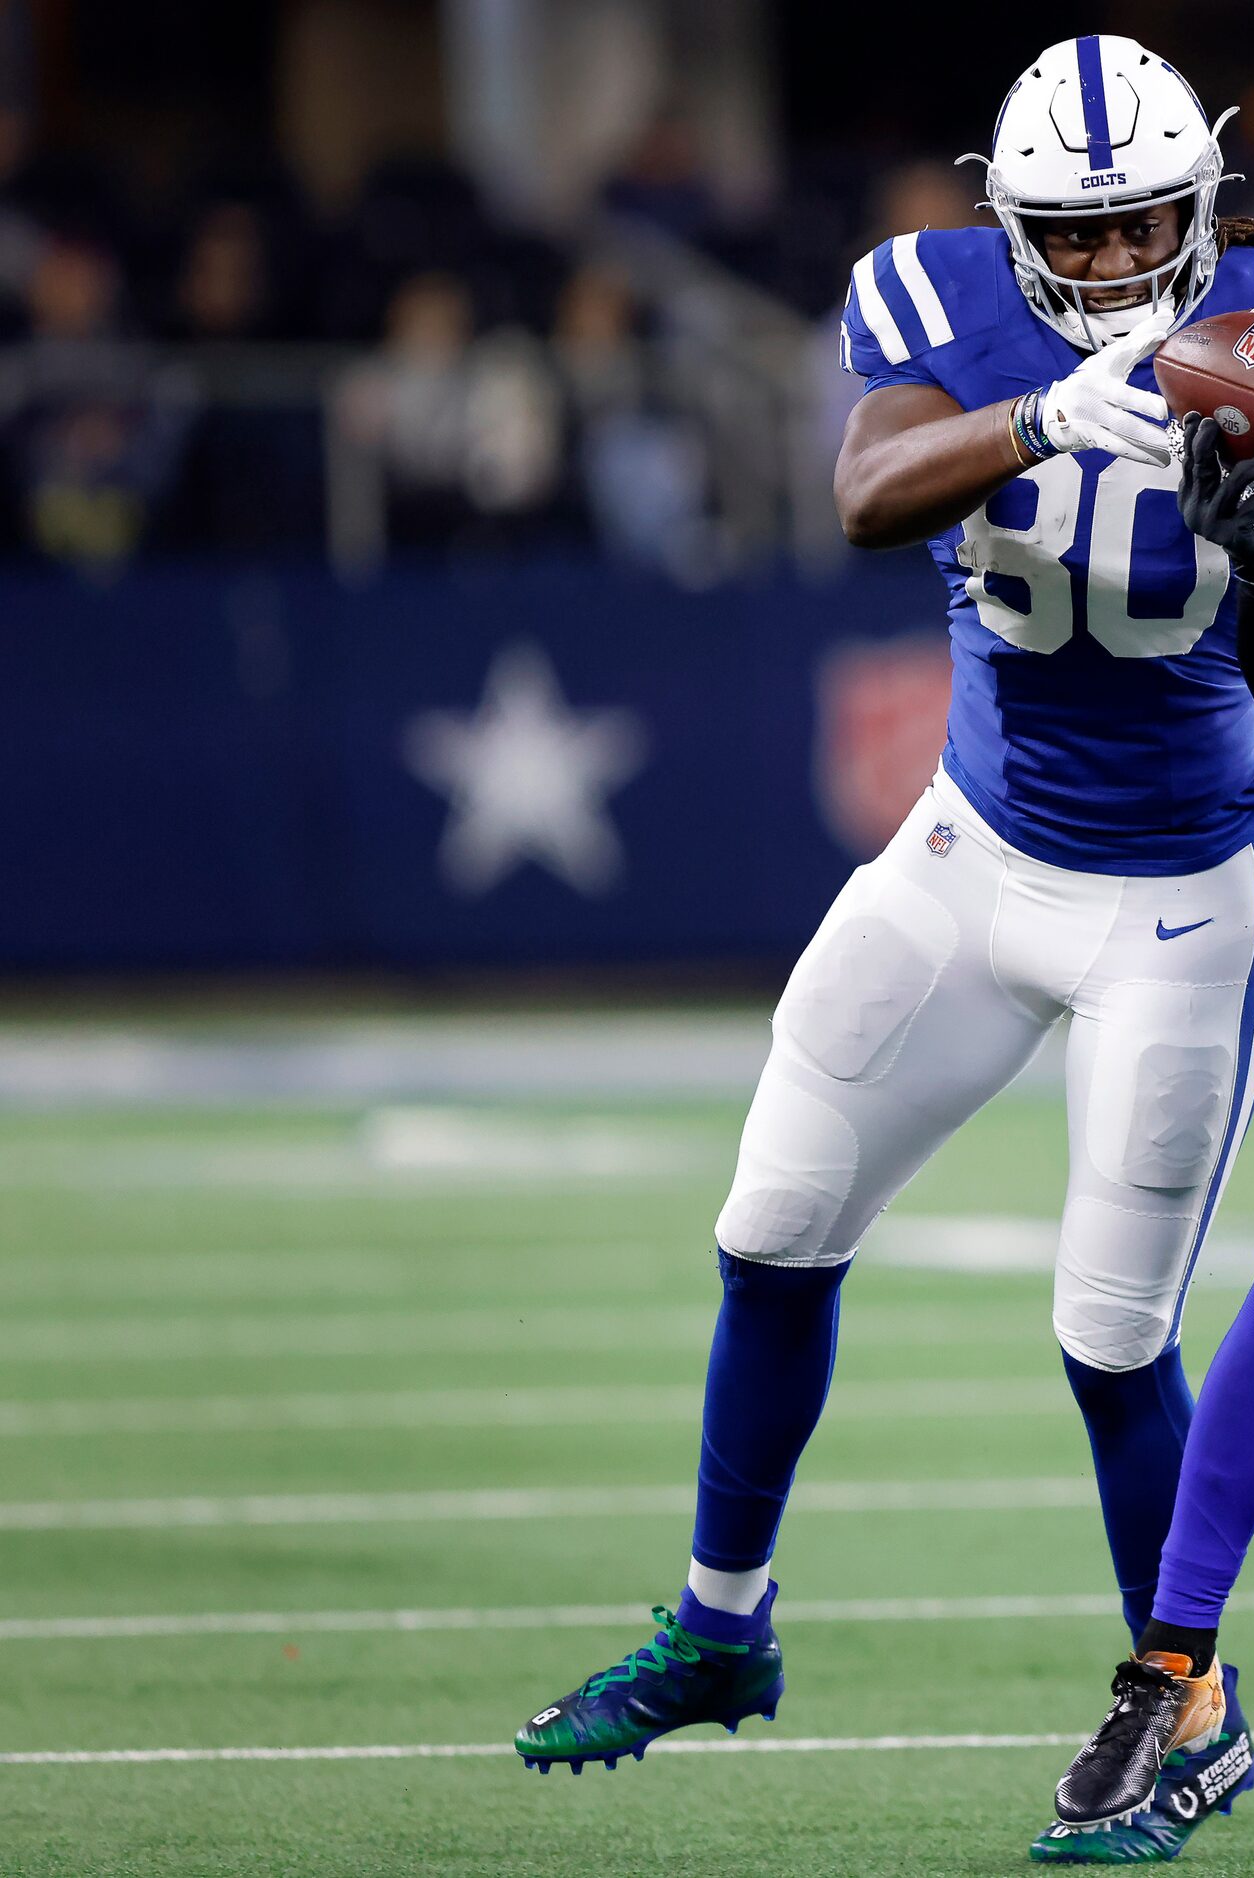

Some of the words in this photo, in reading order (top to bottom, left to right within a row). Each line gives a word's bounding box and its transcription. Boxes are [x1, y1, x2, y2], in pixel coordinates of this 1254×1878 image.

[1080, 173, 1127, 189] COLTS
[1222, 418, 1240, 434] 205
[956, 451, 1230, 658] 80
[929, 833, 947, 853] NFL
[531, 1707, 561, 1726] 8
[1197, 1731, 1250, 1790] KICKING
[1204, 1750, 1253, 1806] STIGMA
